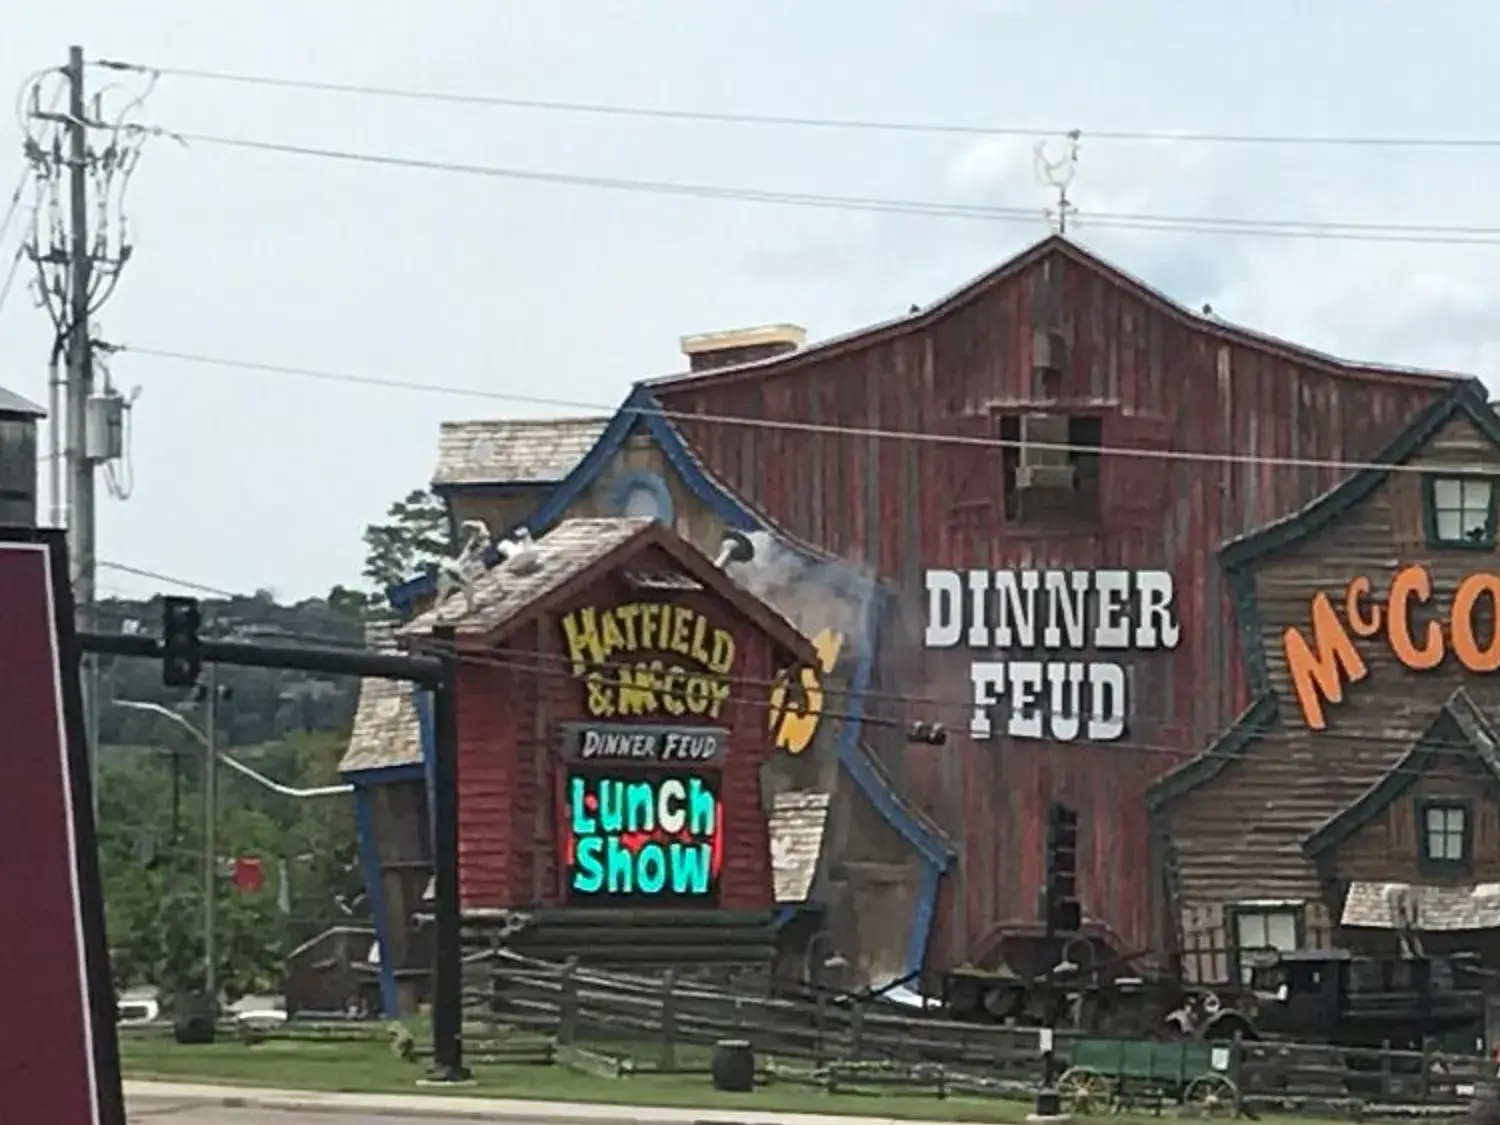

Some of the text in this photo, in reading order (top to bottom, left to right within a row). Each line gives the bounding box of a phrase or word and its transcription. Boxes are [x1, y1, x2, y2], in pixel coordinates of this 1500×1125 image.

[562, 602, 736, 678] HATFIELD
[924, 569, 1180, 649] DINNER
[587, 672, 616, 717] &
[969, 661, 1127, 741] FEUD
[582, 730, 718, 761] DINNER FEUD
